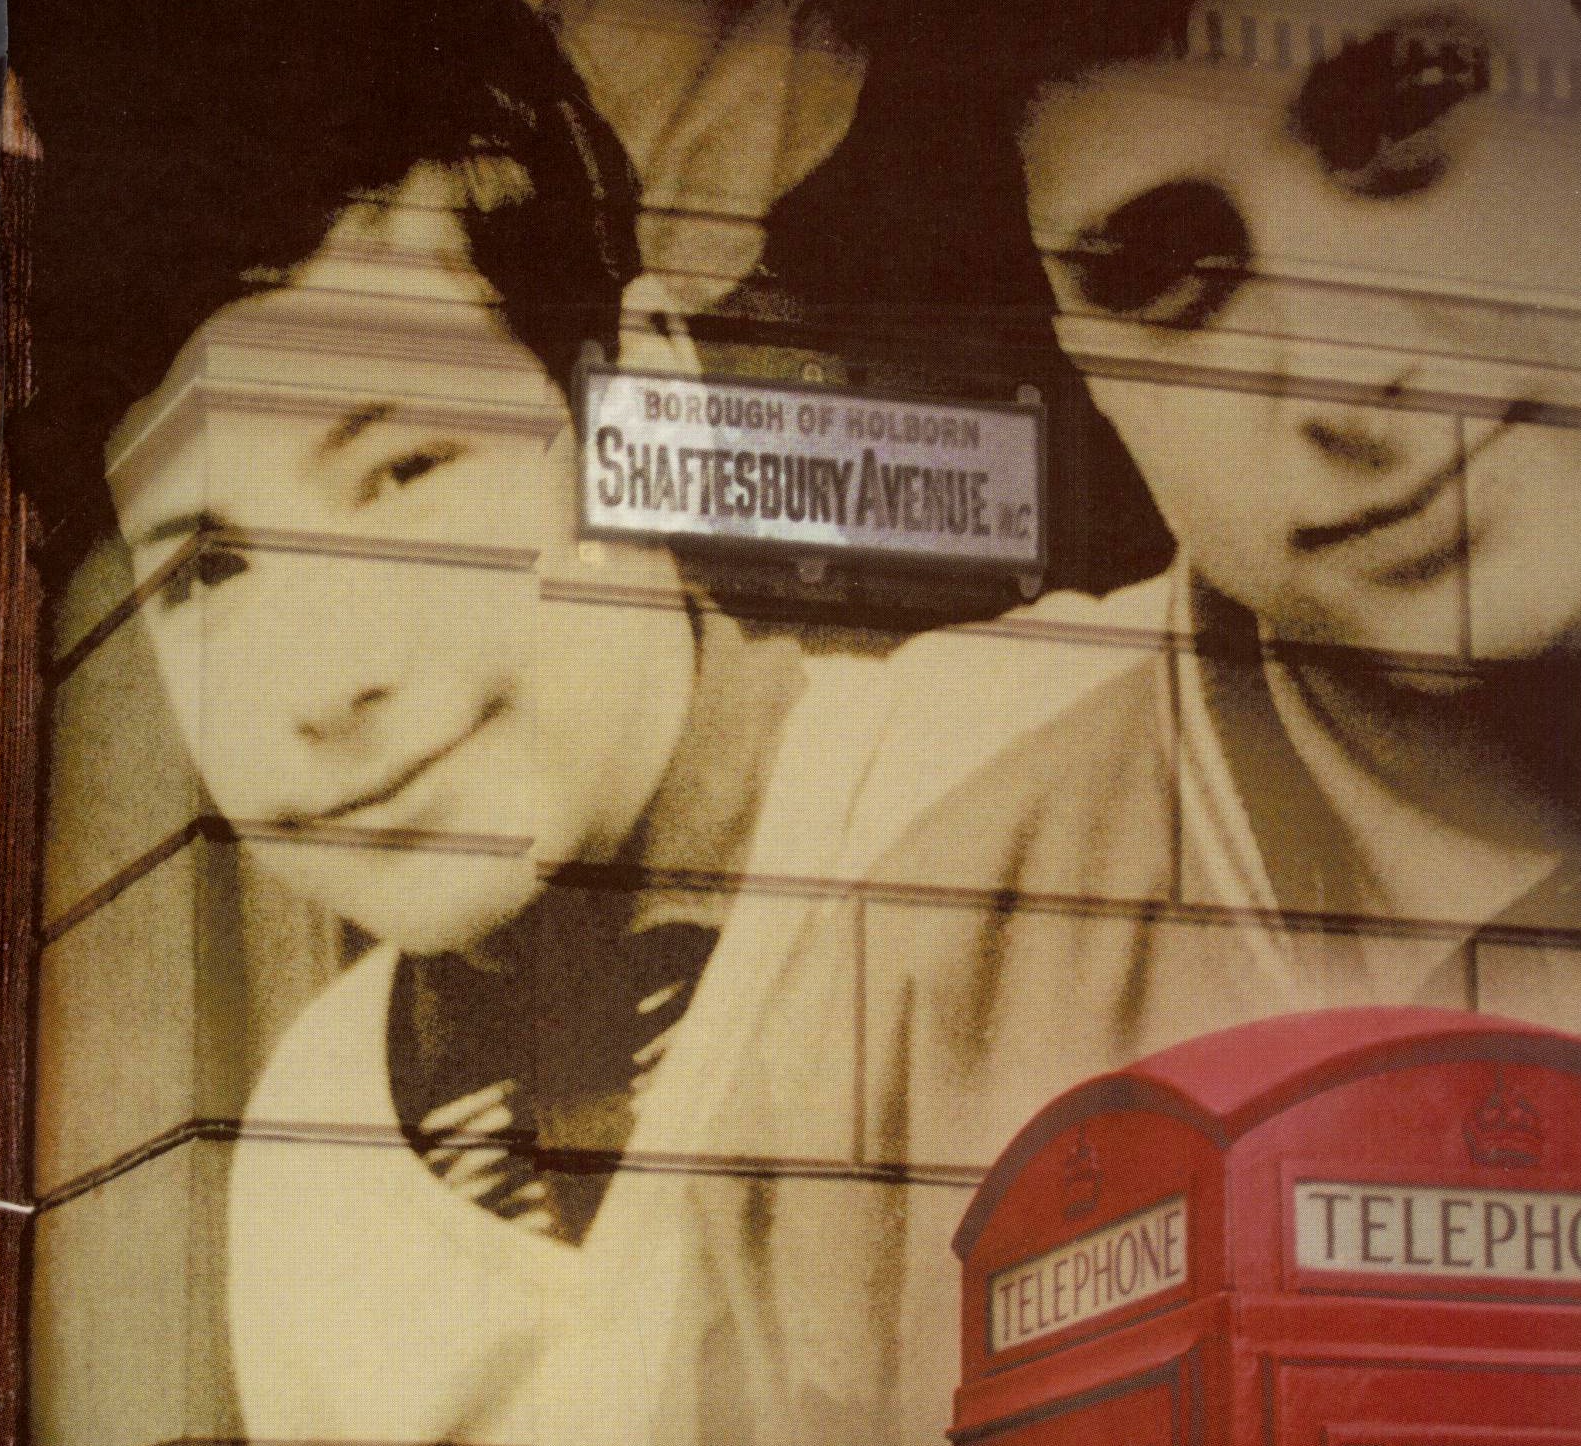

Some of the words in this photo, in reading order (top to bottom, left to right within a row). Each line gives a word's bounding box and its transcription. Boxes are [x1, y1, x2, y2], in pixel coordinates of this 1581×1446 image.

[645, 391, 783, 432] BOROUGH
[797, 403, 833, 436] OF
[846, 407, 980, 448] HOLBORN
[856, 449, 991, 536] AVENUE
[1308, 1193, 1581, 1271] TELEPH
[1000, 1210, 1180, 1342] TELEPHONE
